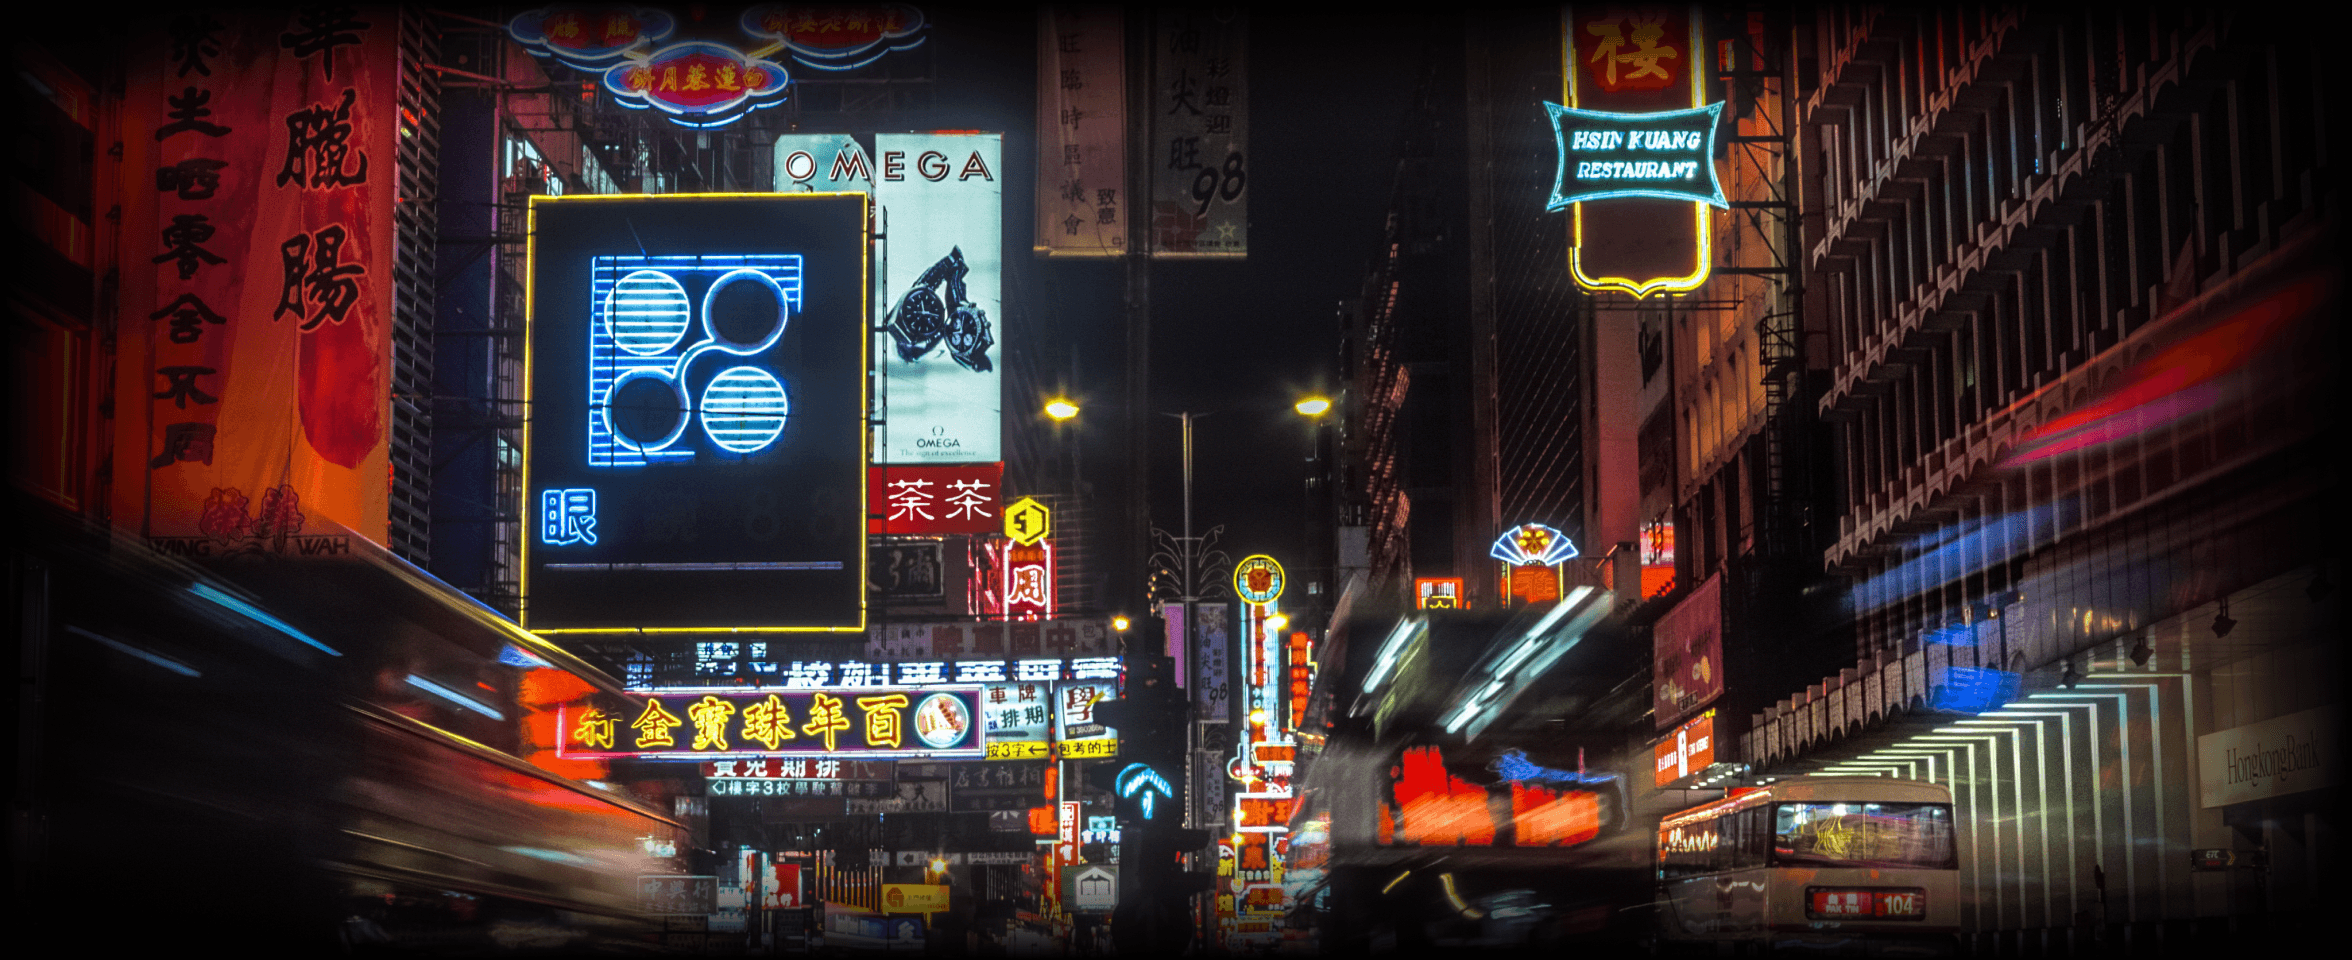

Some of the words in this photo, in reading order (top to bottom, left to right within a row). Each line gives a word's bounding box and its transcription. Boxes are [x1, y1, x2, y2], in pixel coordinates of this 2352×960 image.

[1572, 131, 1625, 150] HSIN
[1627, 131, 1701, 150] KUANG
[785, 150, 994, 183] OMEGA
[1576, 161, 1698, 179] RESTAURANT
[1191, 152, 1246, 217] 98
[916, 438, 961, 448] OMEGA
[542, 488, 597, 546] 眼
[297, 538, 350, 555] WAH
[989, 684, 1037, 704] 車牌
[1001, 705, 1045, 729] 排期
[2226, 729, 2320, 788] HongkongBank
[1884, 895, 1913, 914] 104
